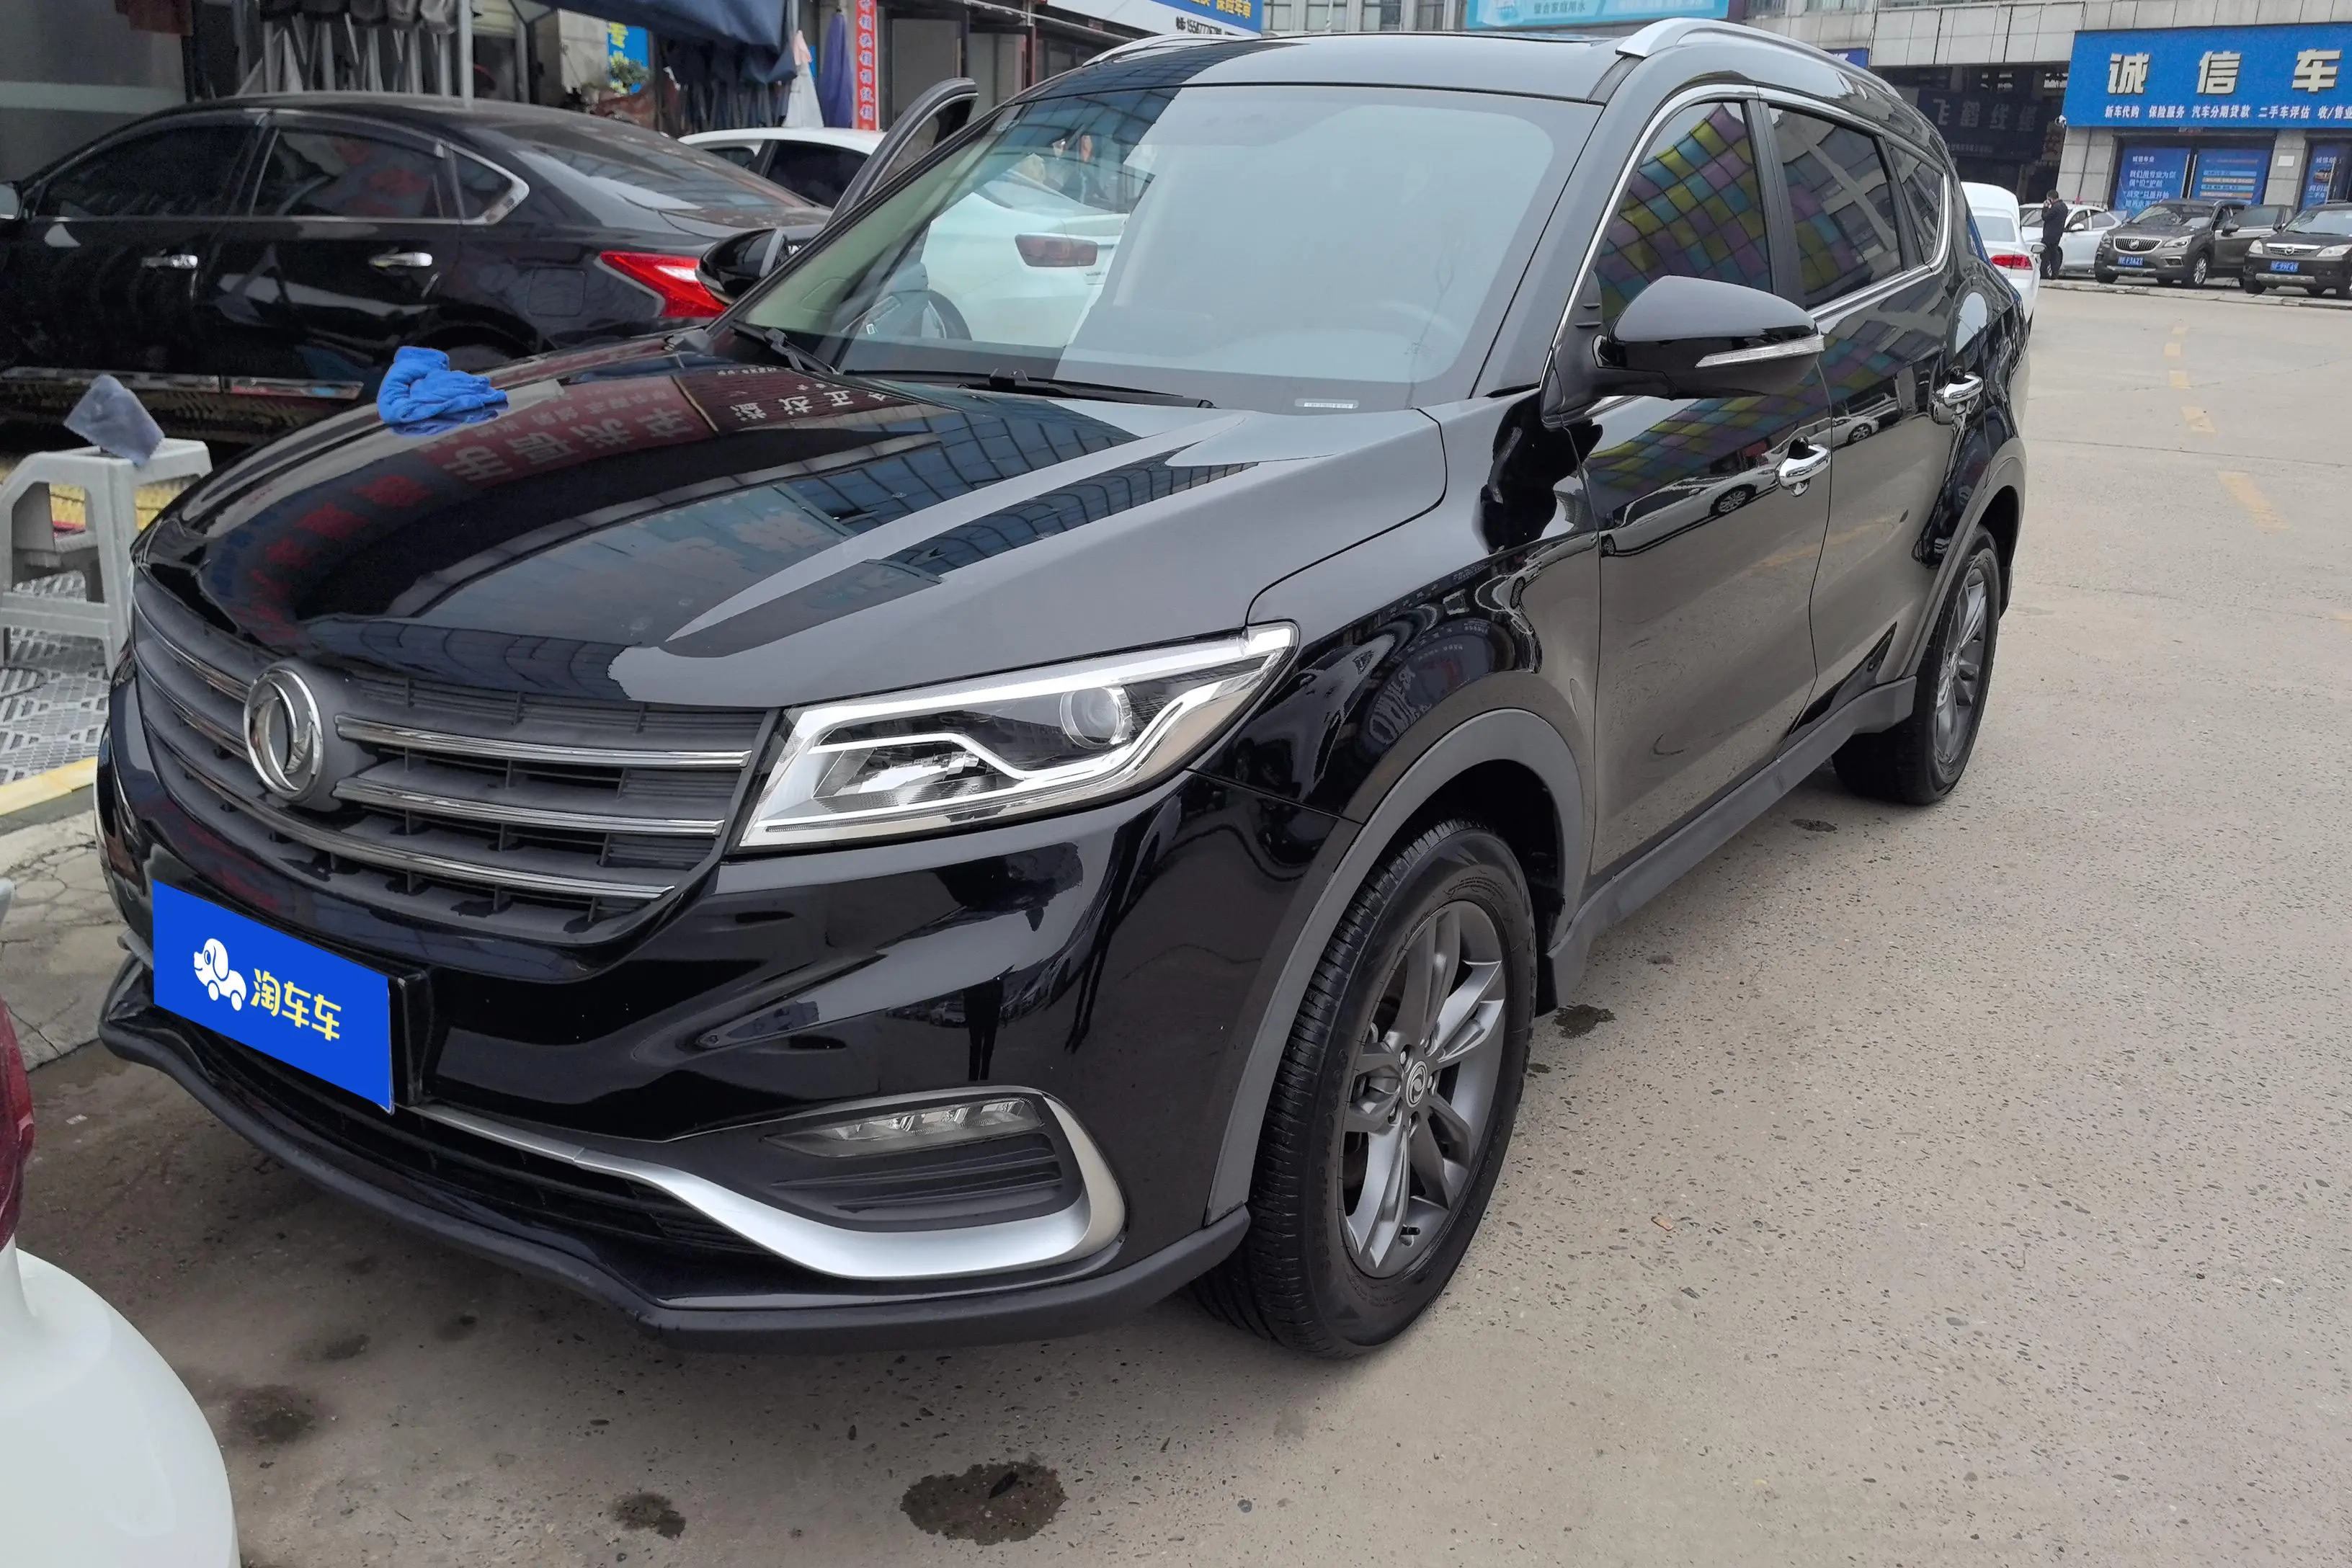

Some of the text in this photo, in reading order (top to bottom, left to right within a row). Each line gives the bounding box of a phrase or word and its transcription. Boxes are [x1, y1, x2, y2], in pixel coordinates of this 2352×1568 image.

[2107, 48, 2342, 94] 诚信车
[2105, 105, 2140, 118] 新车代购
[2148, 105, 2185, 118] 保险服务
[2191, 104, 2250, 118] 汽车分期贷款
[2257, 104, 2310, 119] 二手车评估
